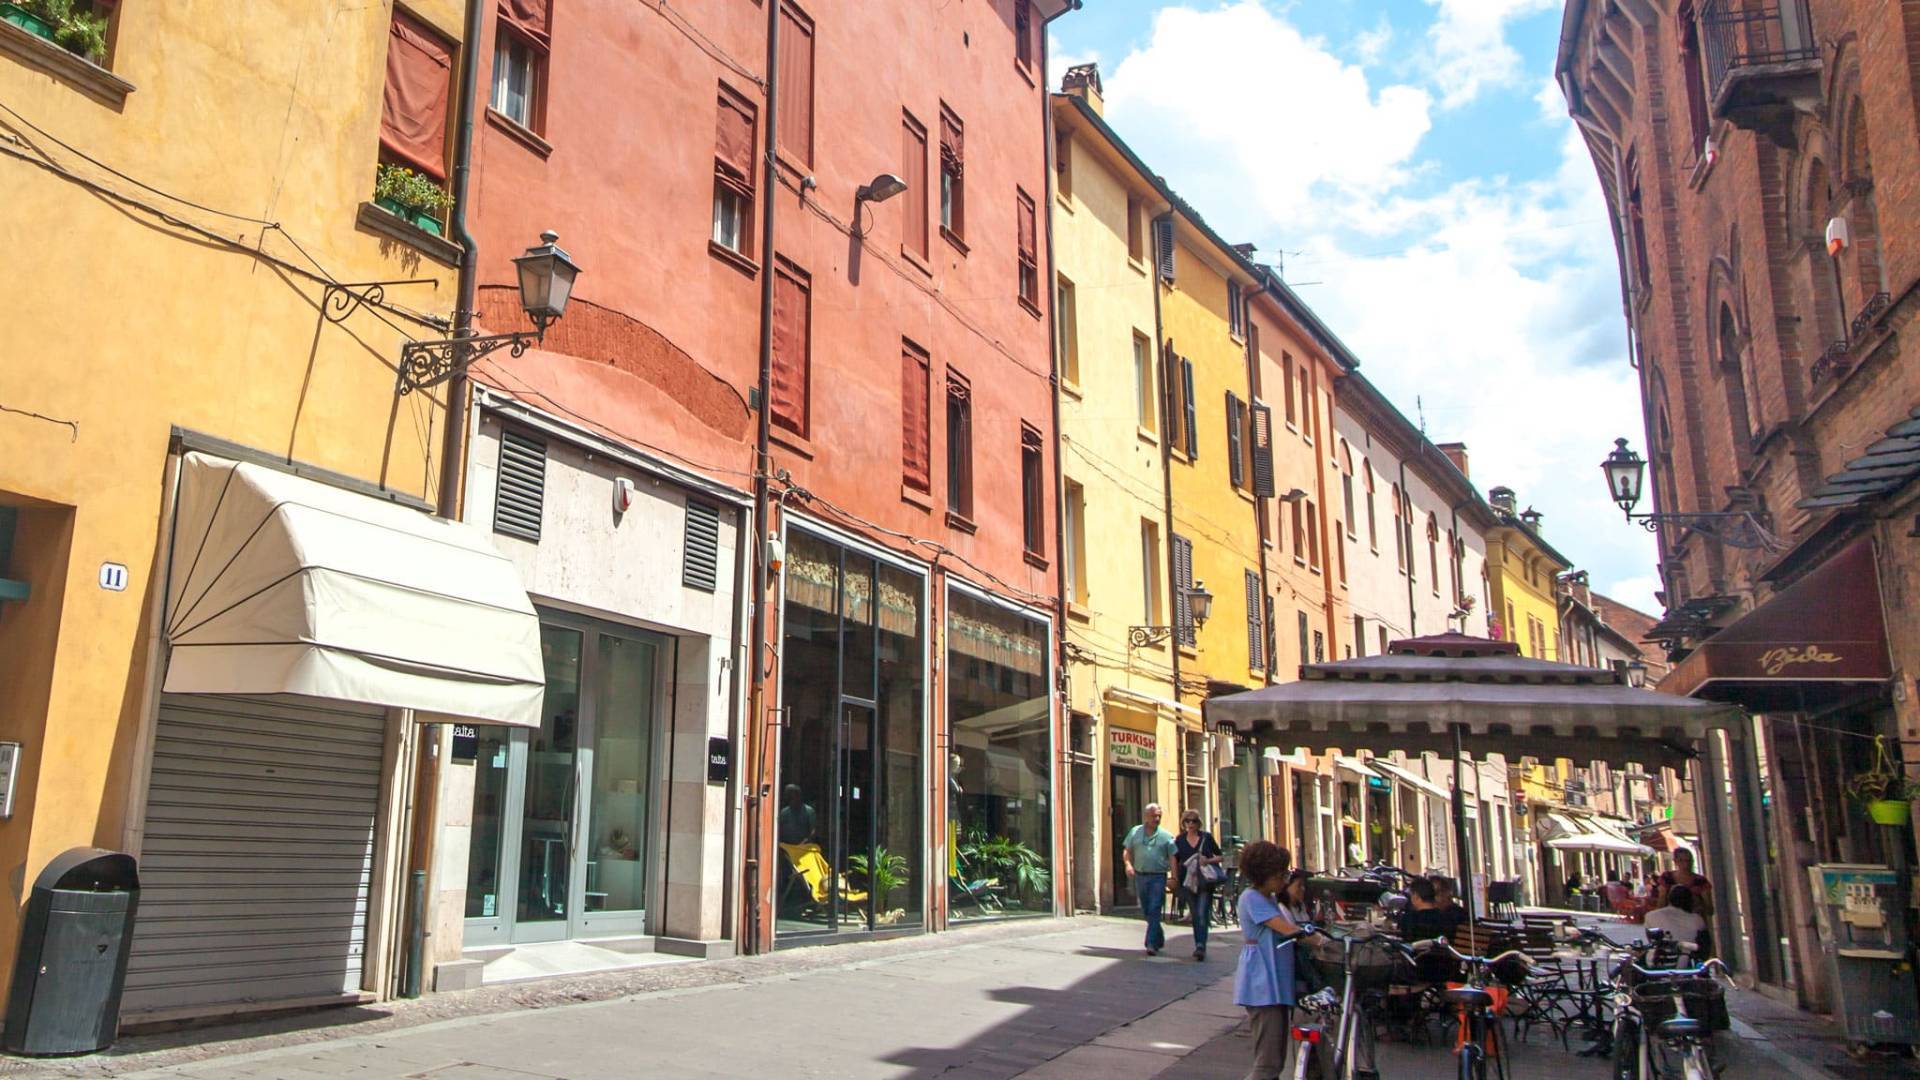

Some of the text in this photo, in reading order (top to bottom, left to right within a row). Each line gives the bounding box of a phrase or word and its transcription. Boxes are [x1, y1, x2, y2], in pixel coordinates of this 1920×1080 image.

[105, 567, 121, 587] 11
[1110, 731, 1156, 750] TURKISH
[1110, 743, 1132, 756] PIZZA
